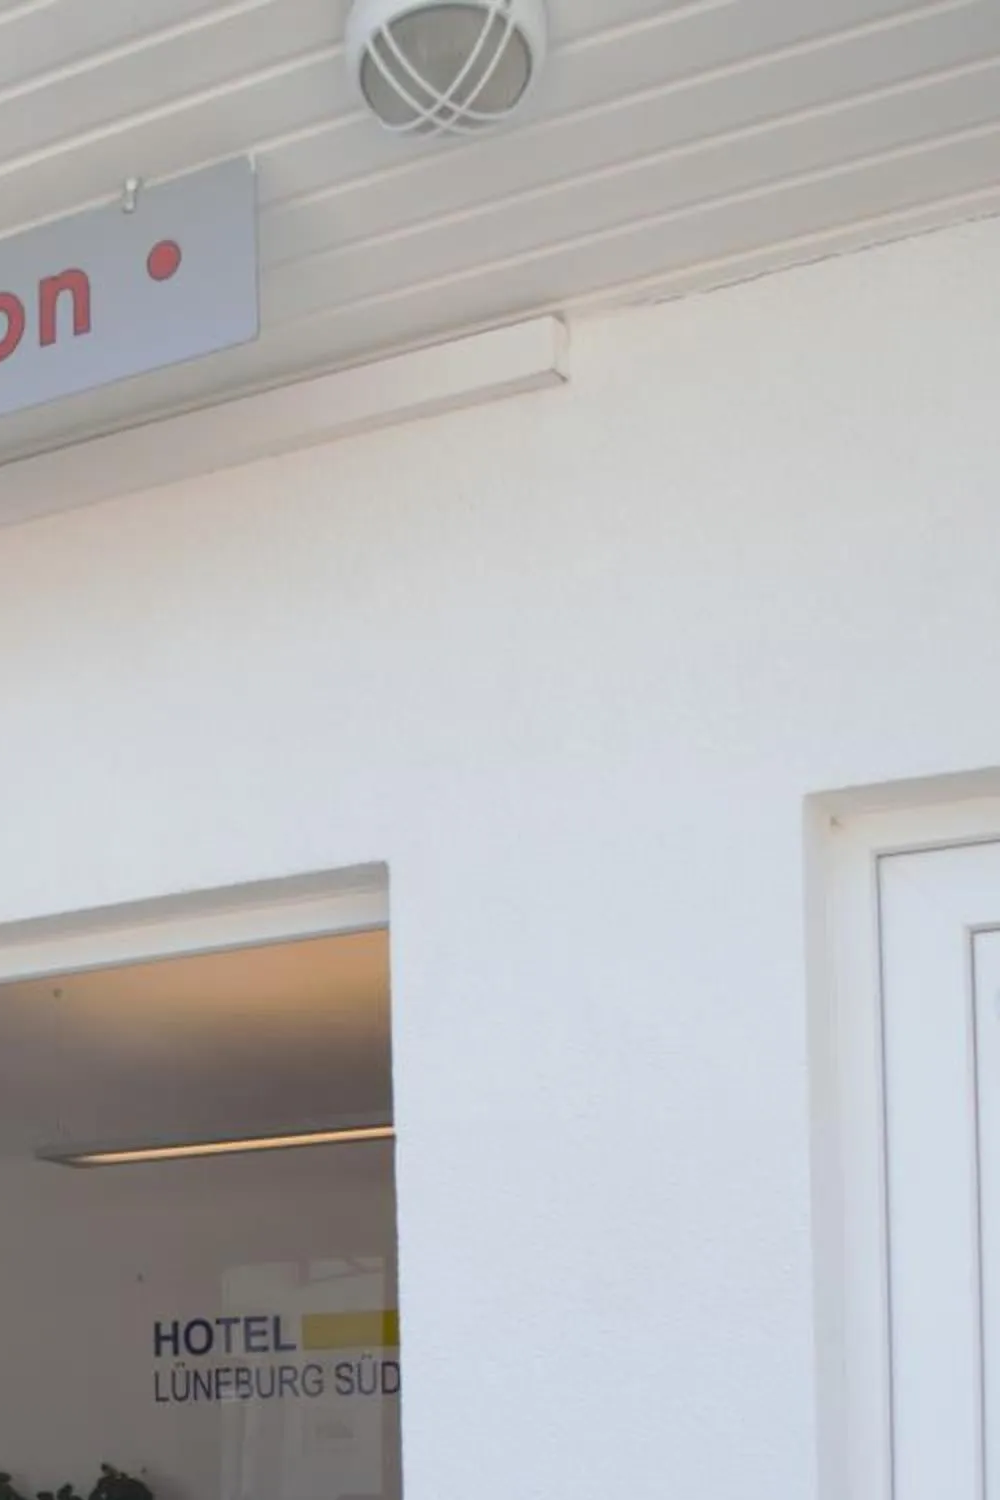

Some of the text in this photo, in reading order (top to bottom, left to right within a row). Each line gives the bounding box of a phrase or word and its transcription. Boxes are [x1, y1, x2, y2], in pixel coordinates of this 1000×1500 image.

[153, 1315, 297, 1357] HOTEL
[154, 1353, 400, 1403] LÜNEBURG SÜD
